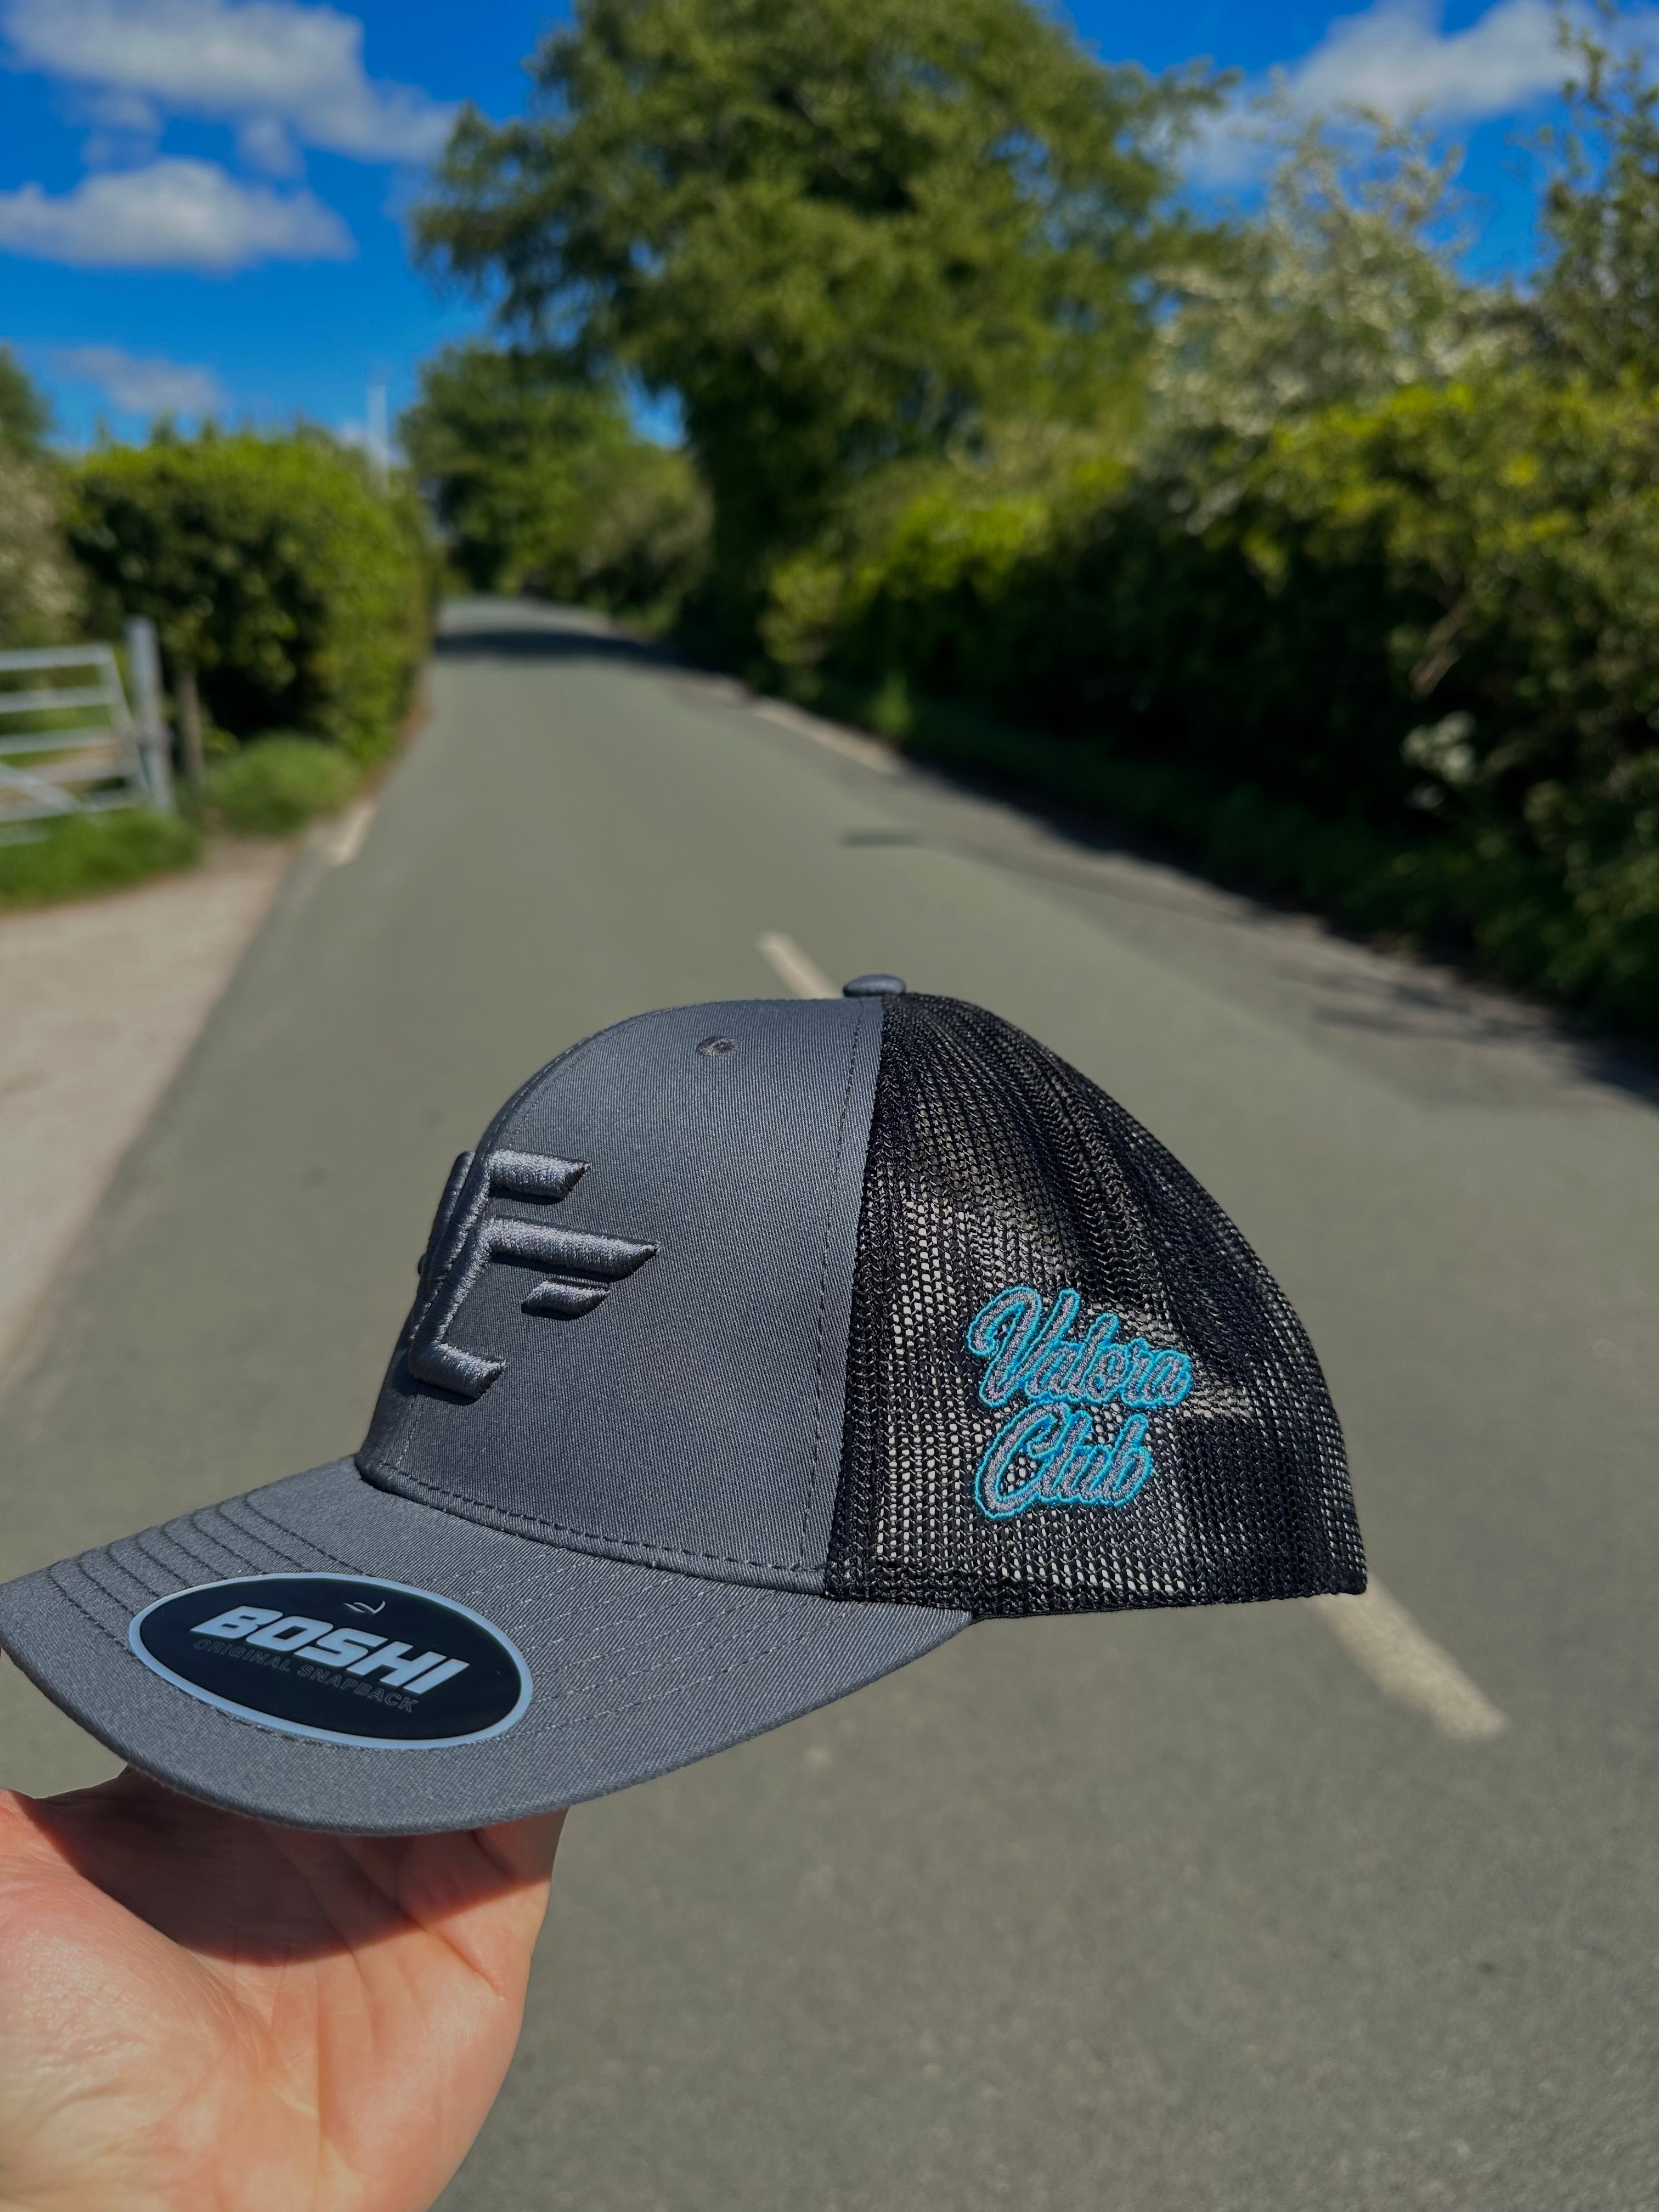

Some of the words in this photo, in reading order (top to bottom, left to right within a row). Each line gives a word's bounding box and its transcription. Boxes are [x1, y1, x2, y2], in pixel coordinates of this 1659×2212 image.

[975, 1400, 1153, 1520] Club
[190, 1605, 470, 1694] BOSHI
[194, 1639, 291, 1672] ORIGINAL
[297, 1664, 420, 1713] SNAPBACK
